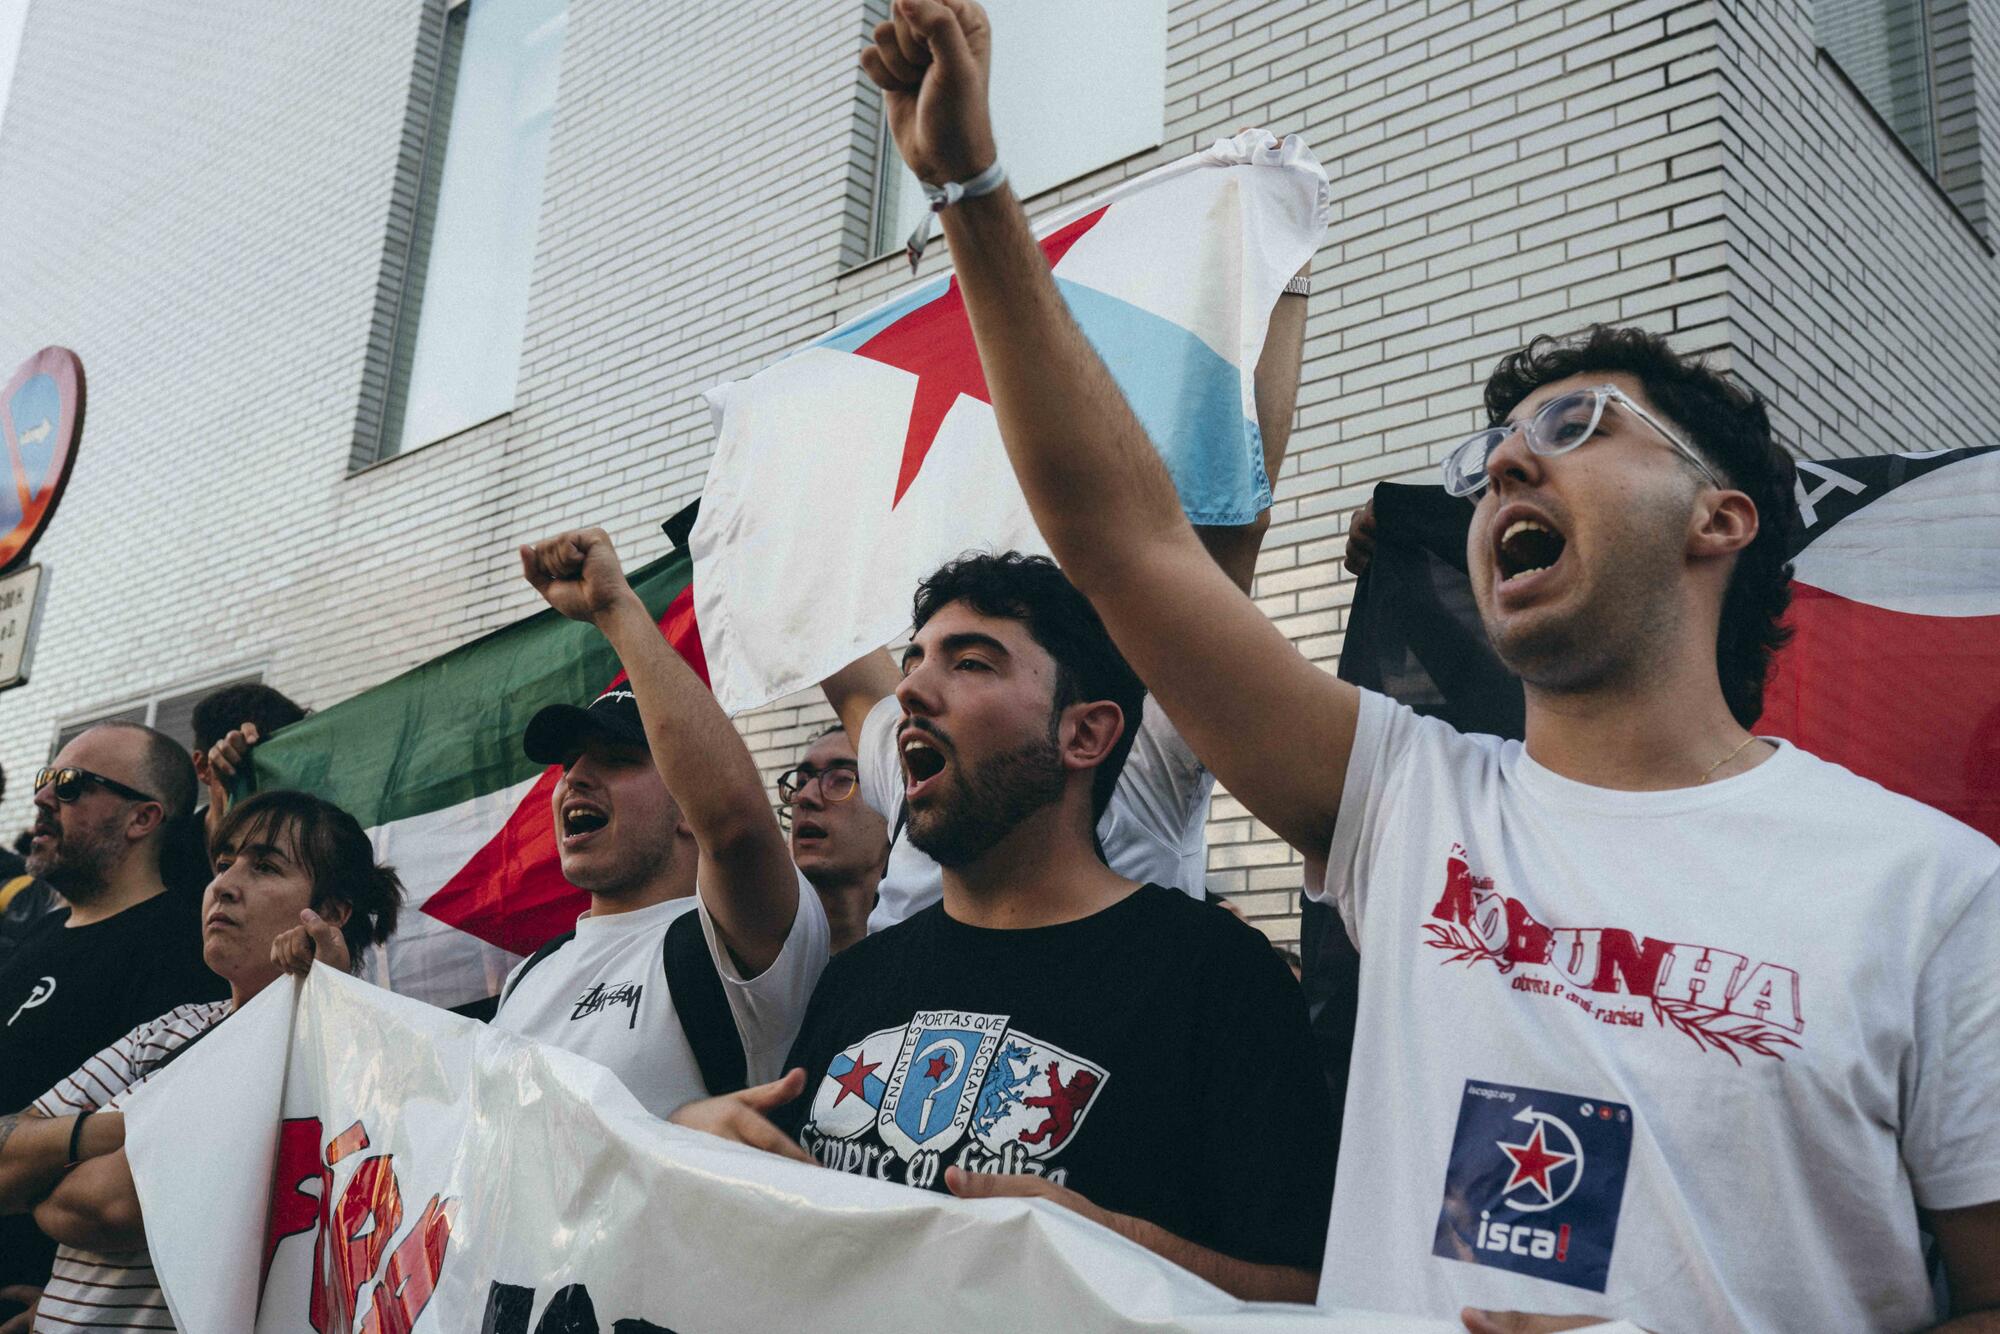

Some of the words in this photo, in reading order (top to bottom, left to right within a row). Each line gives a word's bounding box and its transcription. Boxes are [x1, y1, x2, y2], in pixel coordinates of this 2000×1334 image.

[913, 1012, 972, 1027] MORTAS
[880, 1026, 921, 1124] DENANTES
[953, 1036, 997, 1129] ESCRAVAS
[906, 1149, 940, 1187] en
[1476, 1210, 1571, 1262] isca!
